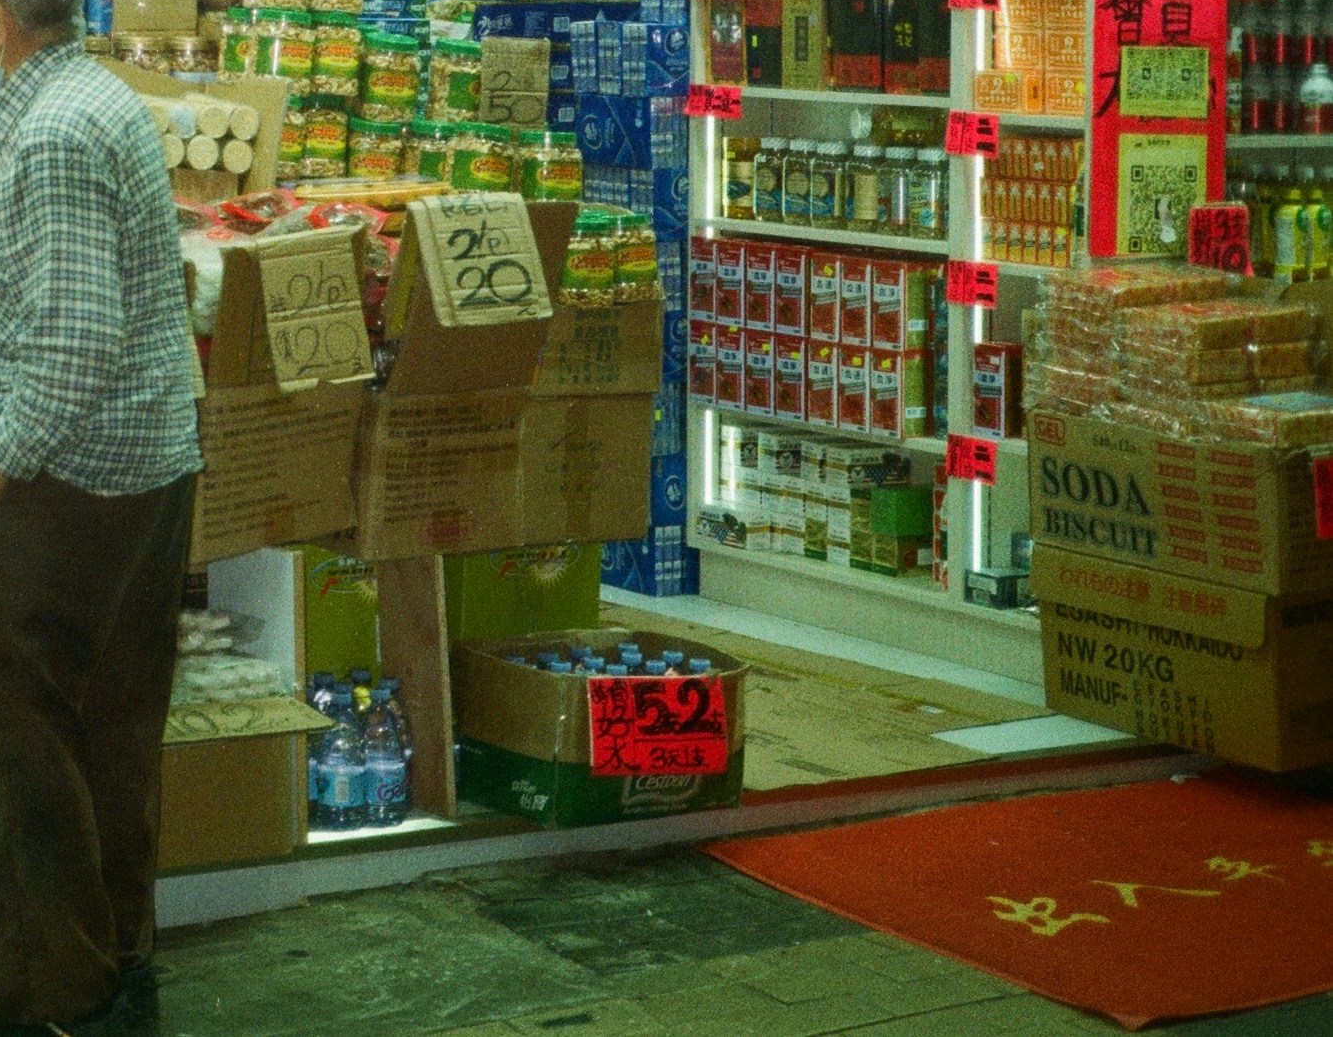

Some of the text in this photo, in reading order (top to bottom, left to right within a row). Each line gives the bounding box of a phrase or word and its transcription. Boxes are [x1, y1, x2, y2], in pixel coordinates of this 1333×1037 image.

[456, 259, 533, 308] 20
[1039, 455, 1151, 517] SODA
[1044, 506, 1158, 560] BISCUIT
[1057, 631, 1097, 663] NW
